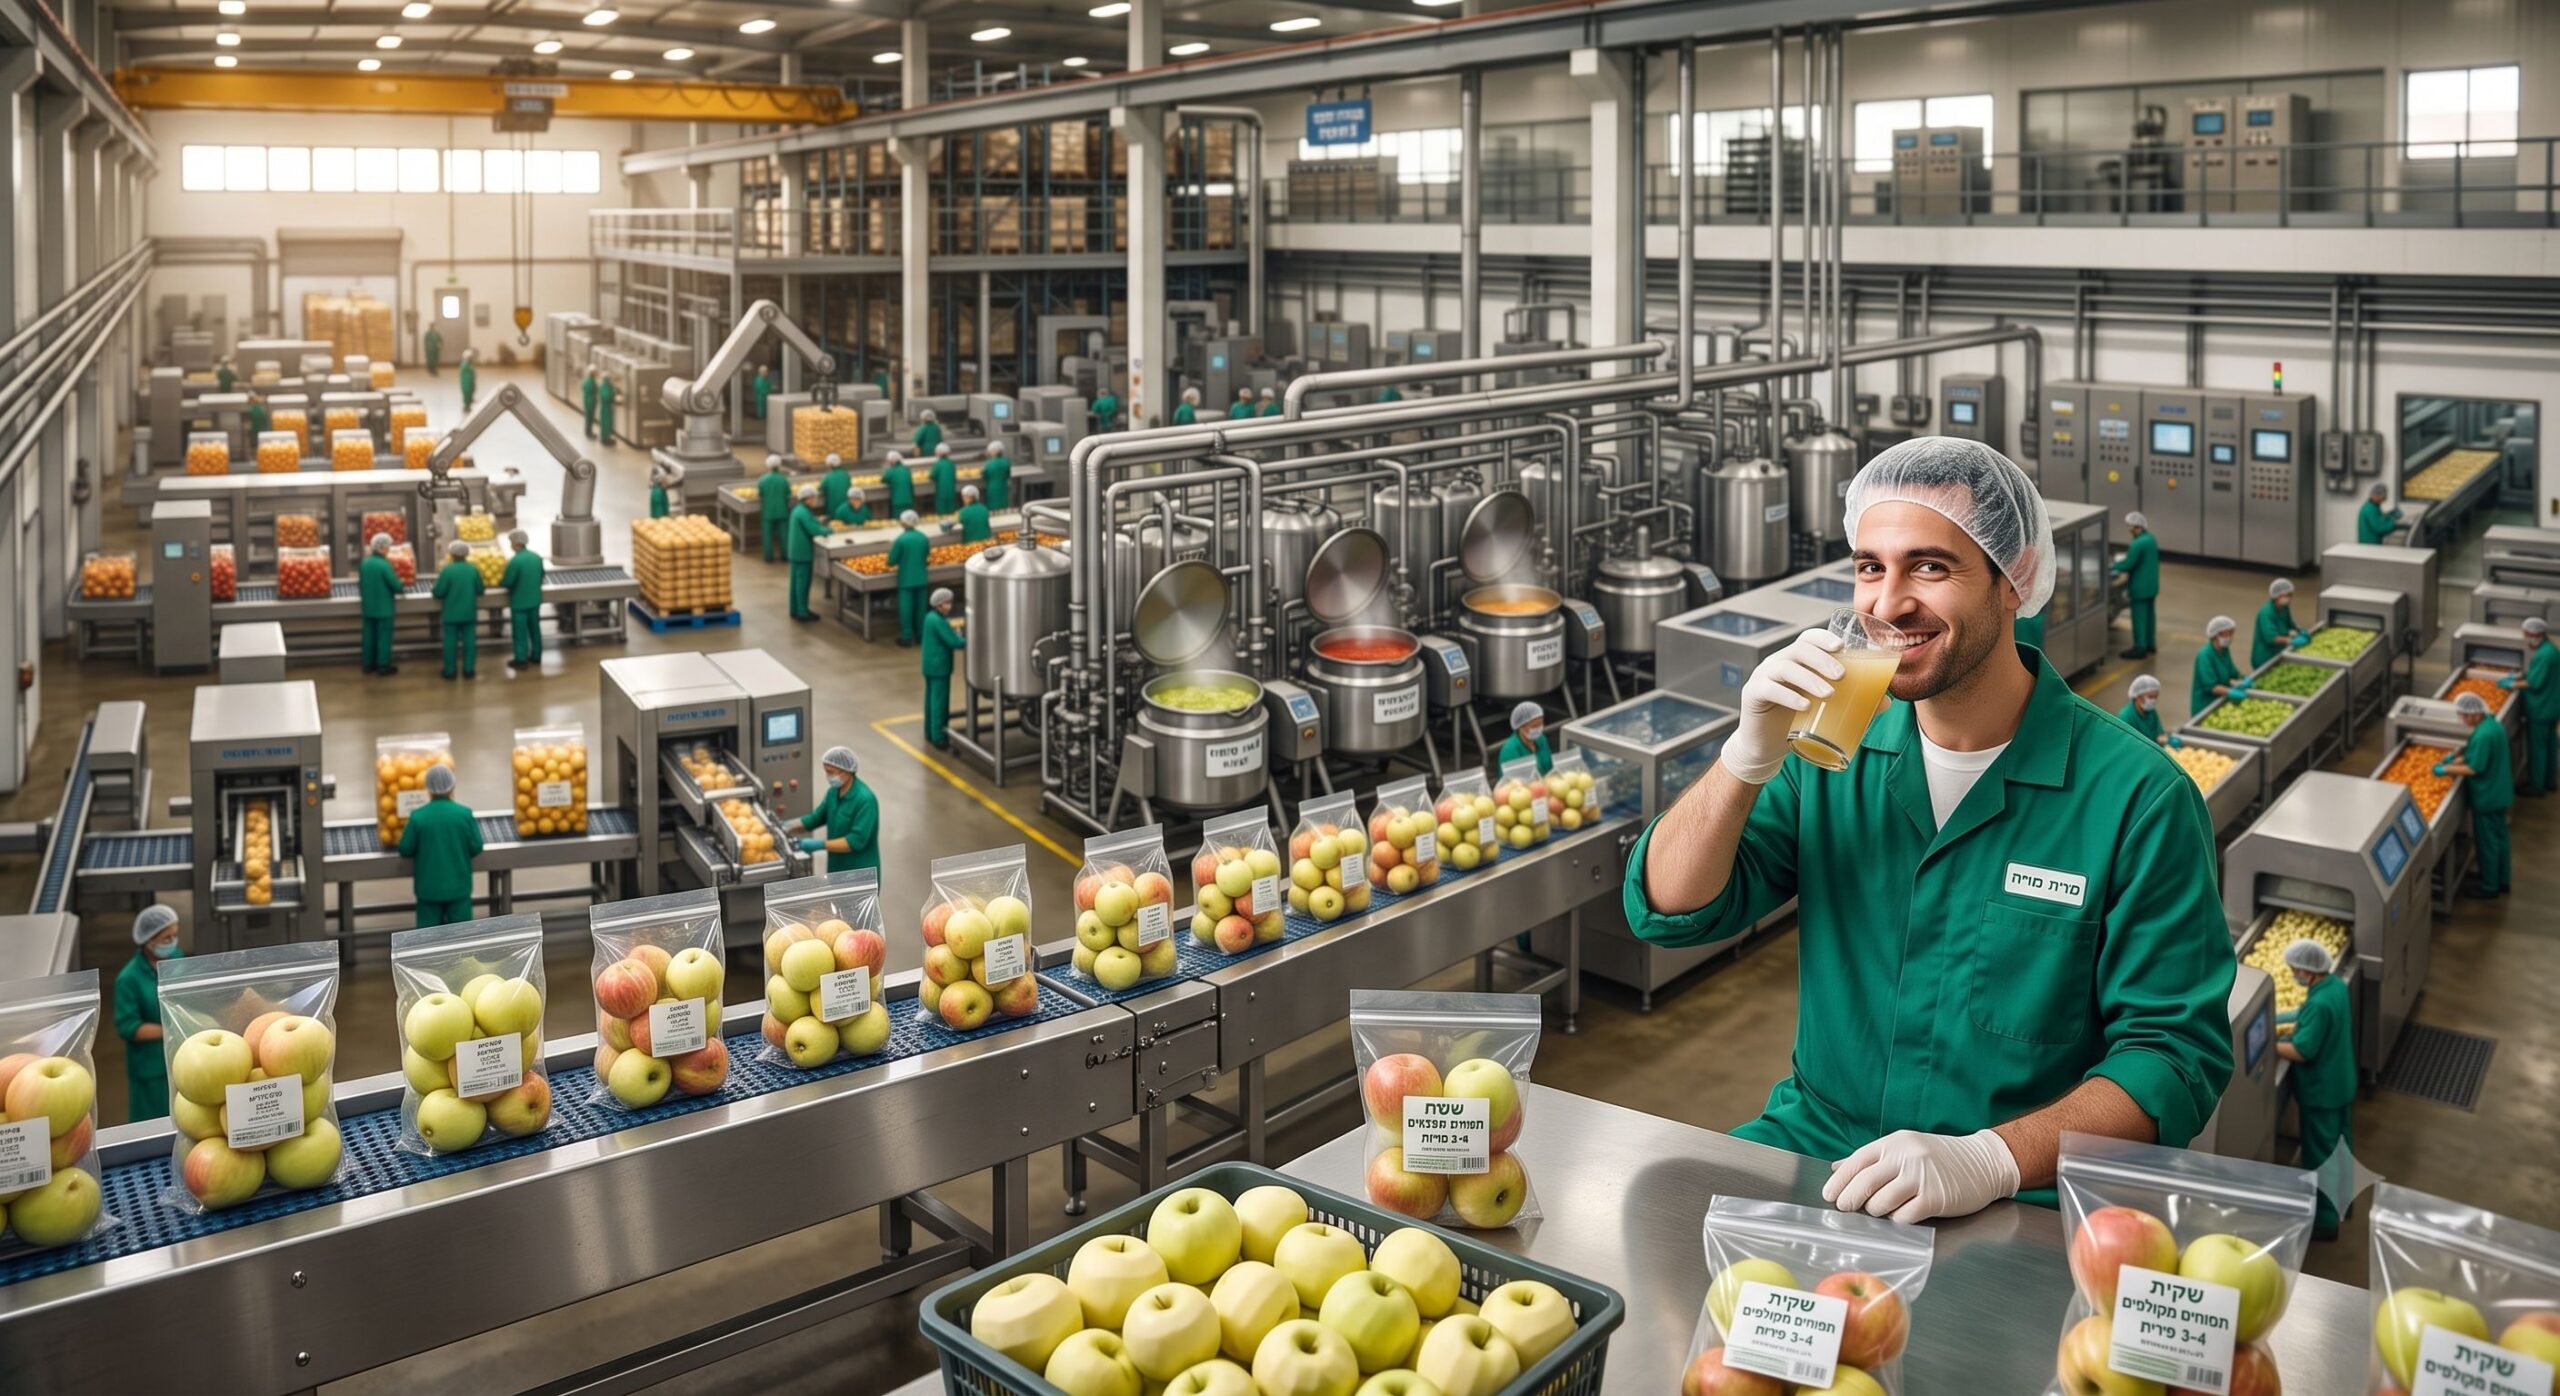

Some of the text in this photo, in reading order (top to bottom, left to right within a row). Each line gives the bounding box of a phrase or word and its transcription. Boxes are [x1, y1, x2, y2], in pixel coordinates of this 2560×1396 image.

[2149, 1280, 2204, 1303] שקית
[1768, 1293, 1815, 1312] שקית
[1742, 1306, 1836, 1334] תפוחים מקולפים
[1790, 1332, 1813, 1346] 3-4
[2181, 1329, 2206, 1346] 3-4
[2454, 1344, 2515, 1377] שקית
